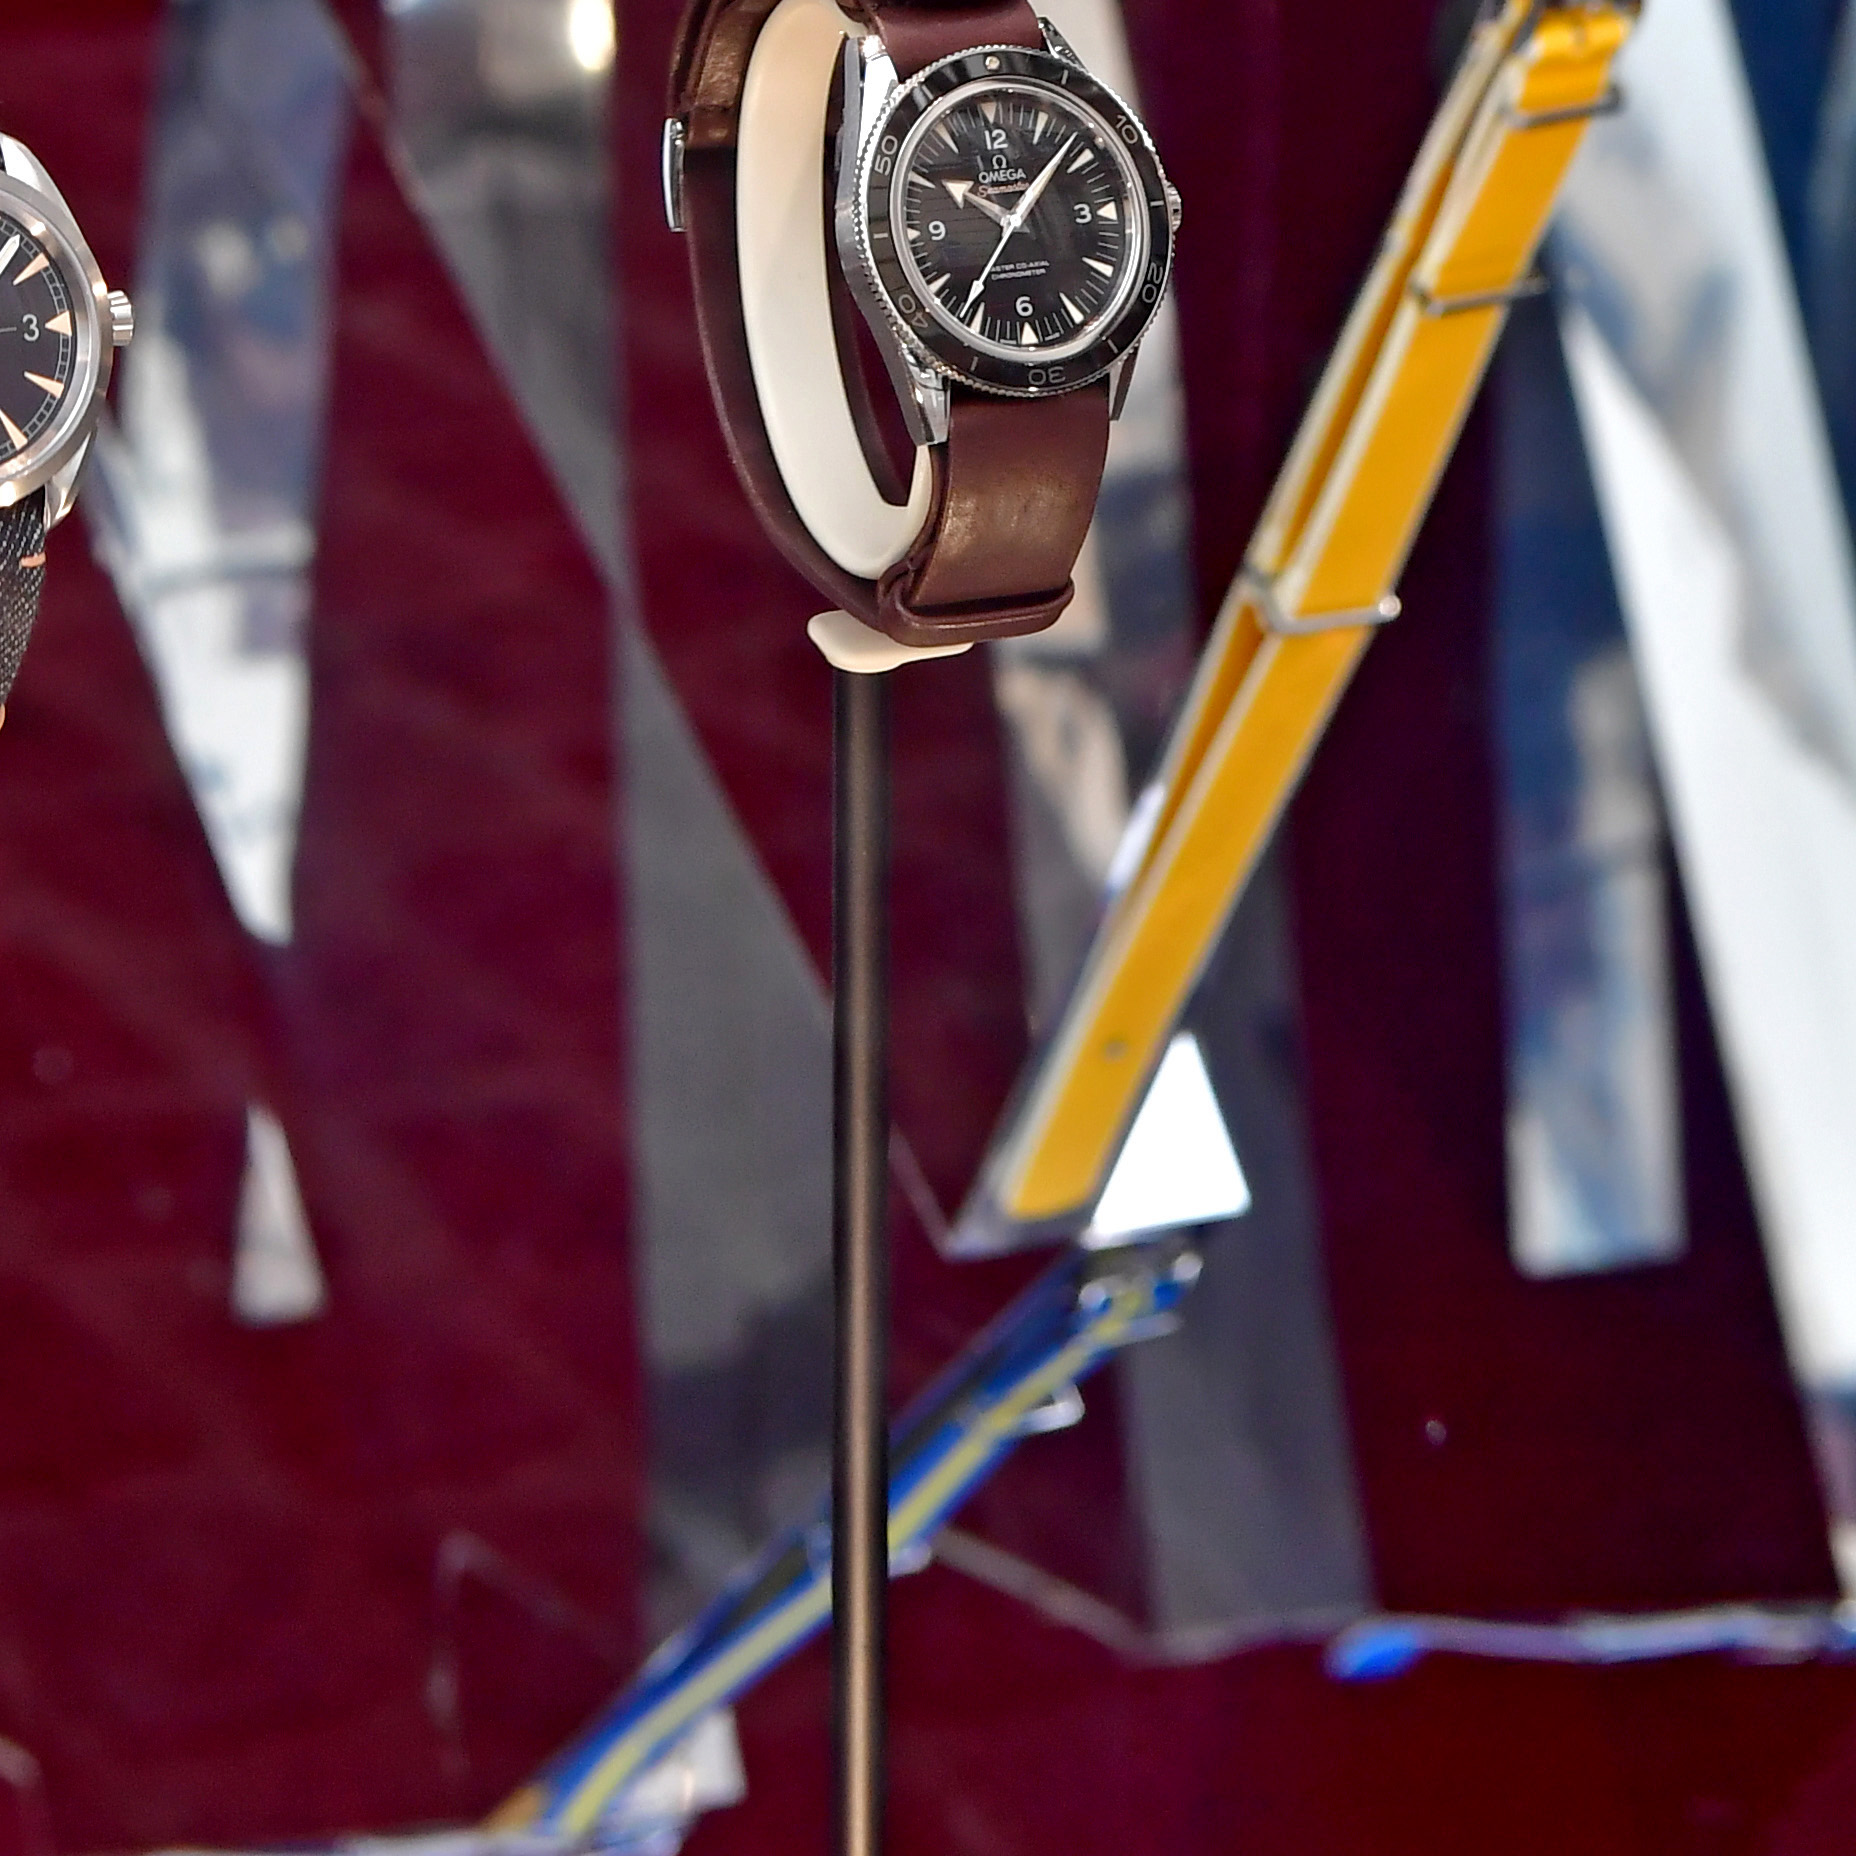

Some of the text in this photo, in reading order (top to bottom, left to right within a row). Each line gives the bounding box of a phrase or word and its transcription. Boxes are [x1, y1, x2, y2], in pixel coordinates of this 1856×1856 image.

[984, 129, 1009, 151] 12
[1115, 114, 1139, 145] 10
[874, 135, 898, 176] 50
[978, 168, 1027, 184] OMEGA
[1074, 203, 1092, 224] 3
[928, 220, 946, 241] 9
[990, 263, 1015, 273] ASTER
[1142, 261, 1163, 303] 20
[898, 294, 929, 328] 40
[1015, 295, 1034, 317] 6
[22, 314, 40, 342] 3
[1028, 367, 1066, 386] 30
